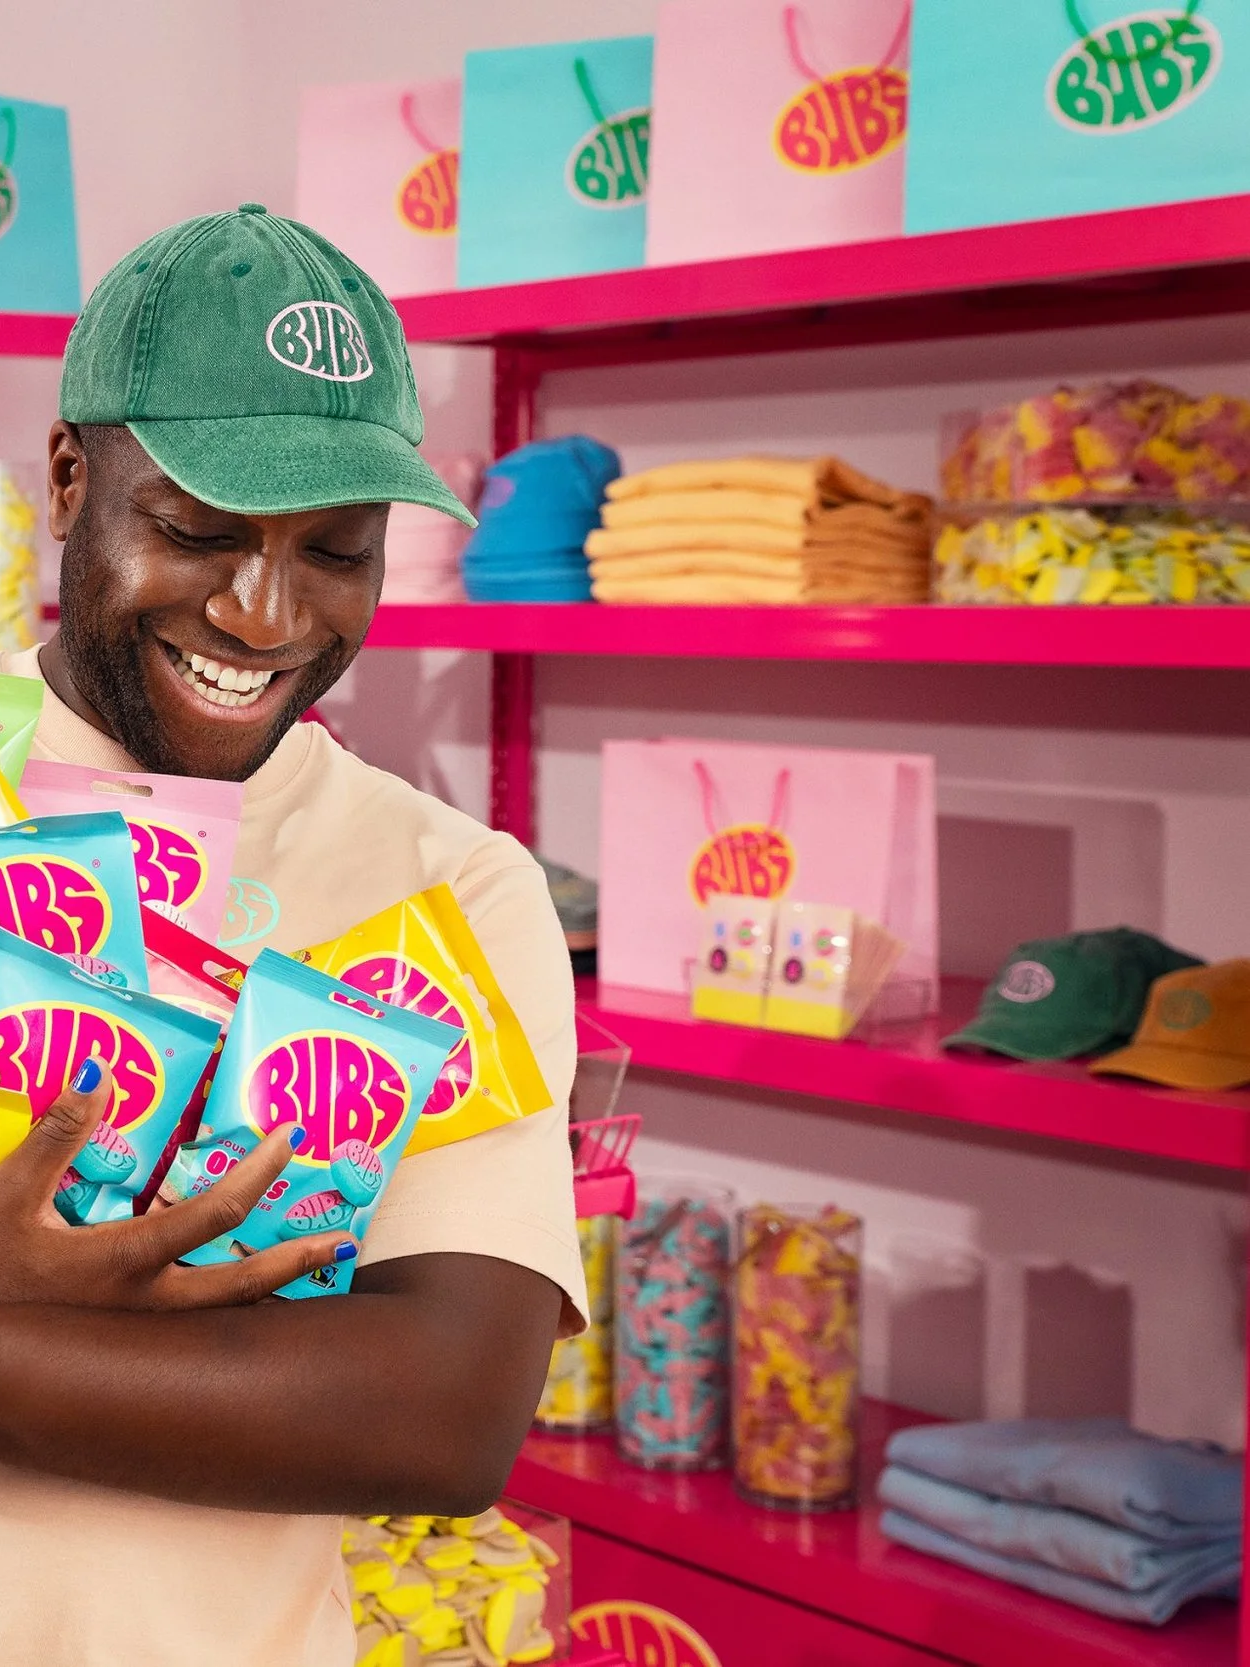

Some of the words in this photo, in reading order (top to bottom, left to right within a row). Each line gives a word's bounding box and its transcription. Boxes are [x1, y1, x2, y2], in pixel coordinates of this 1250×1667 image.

[1056, 19, 1212, 128] BUBS
[270, 305, 369, 379] BUBS
[249, 1036, 406, 1162] BUBS
